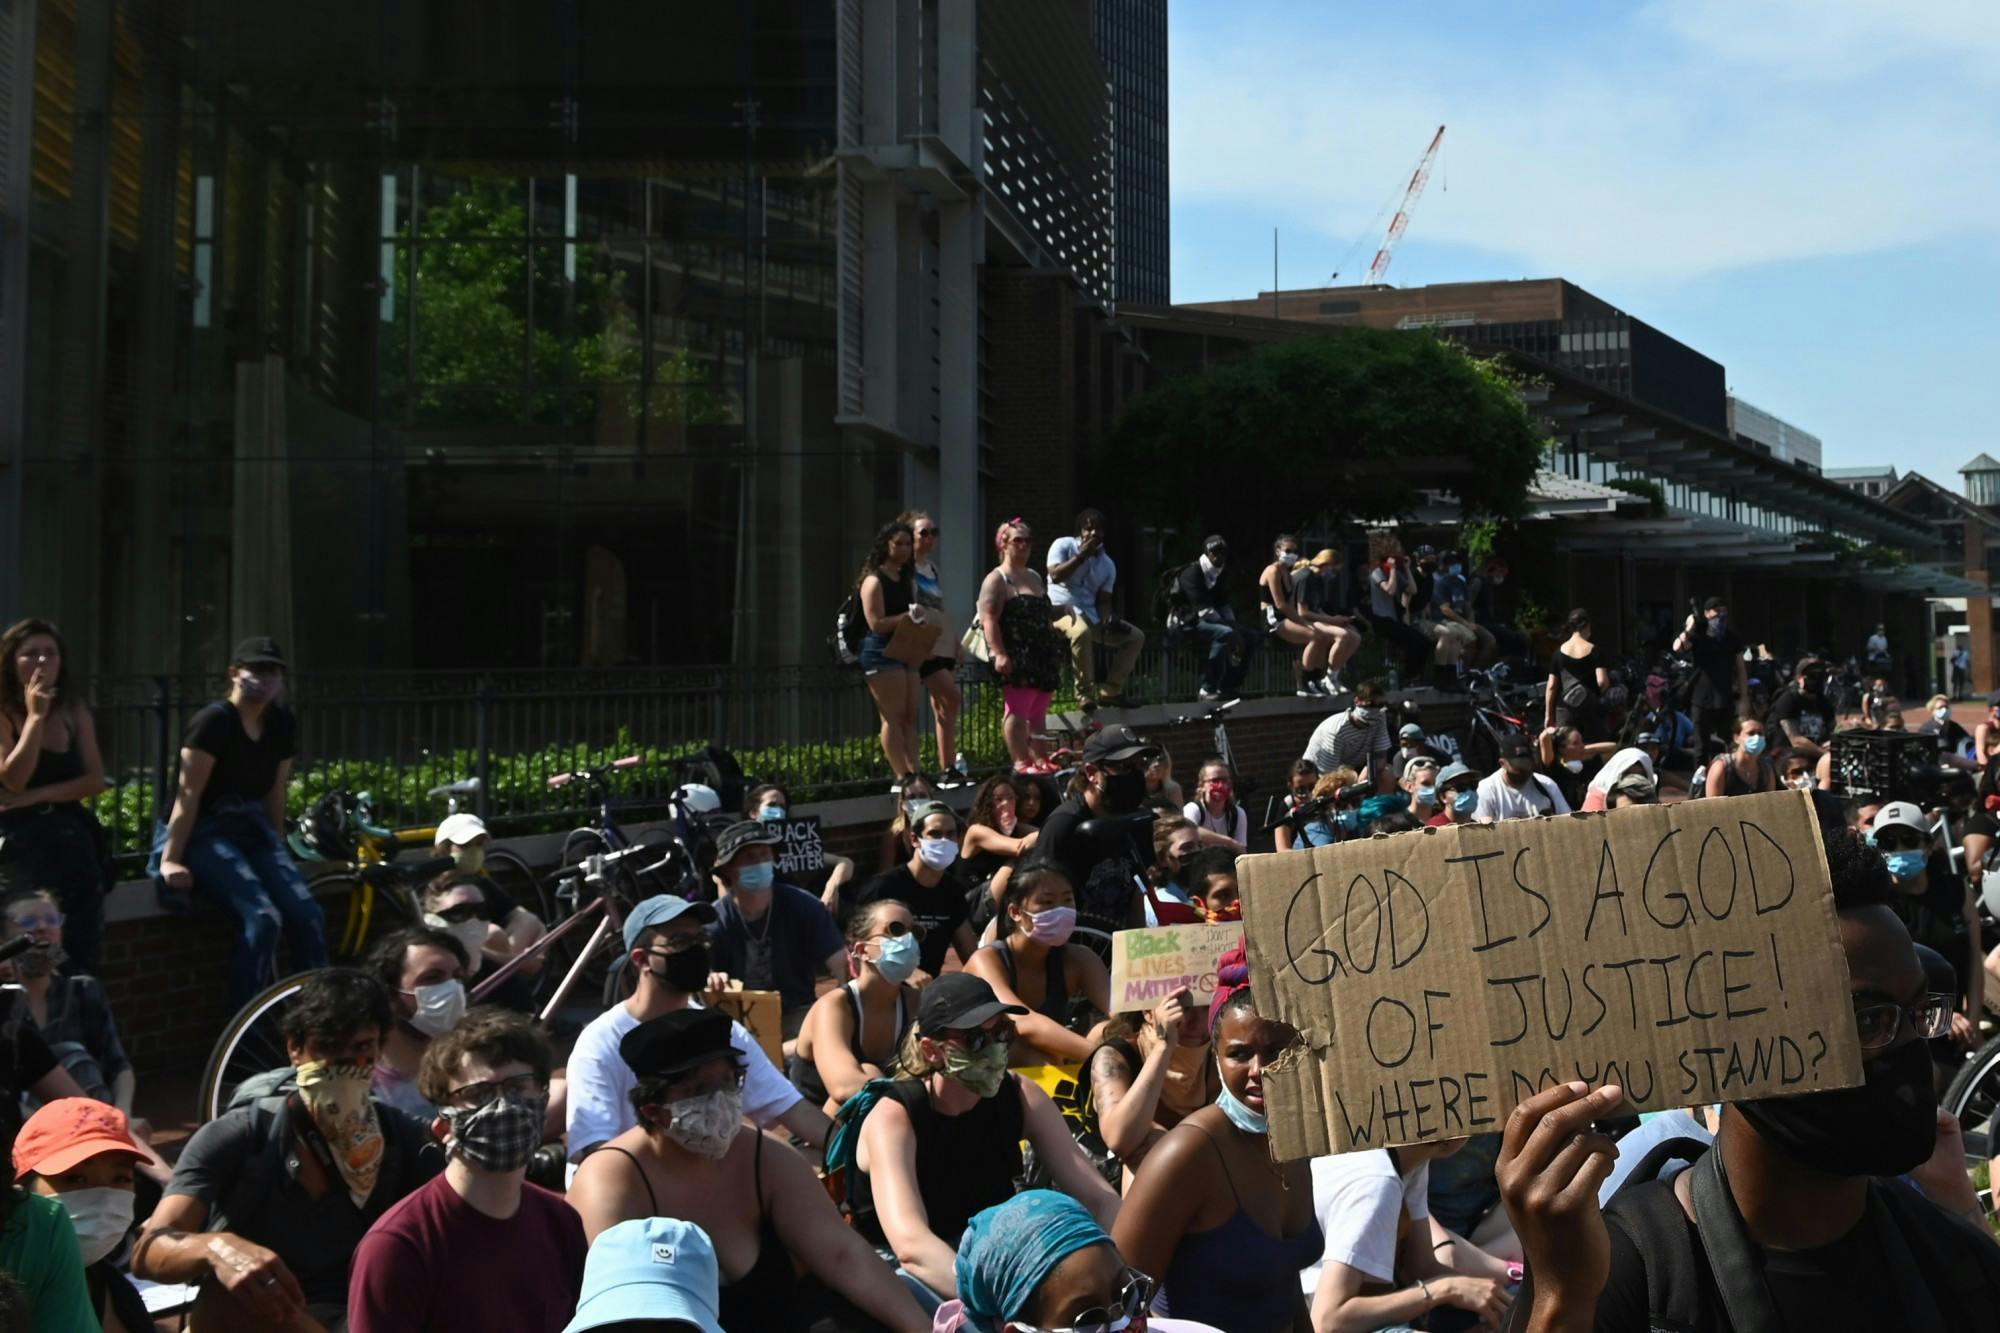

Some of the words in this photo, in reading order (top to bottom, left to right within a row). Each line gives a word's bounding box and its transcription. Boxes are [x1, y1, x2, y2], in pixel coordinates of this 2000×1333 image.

[768, 822, 820, 842] BLACK
[1284, 869, 1429, 985] GOD
[1444, 847, 1551, 952] IS
[1584, 839, 1625, 941] A
[1642, 820, 1795, 929] GOD
[1127, 955, 1185, 978] LIVES
[1366, 990, 1450, 1068] OF
[1489, 933, 1788, 1047] JUSTICE!
[1335, 1072, 1496, 1147] WHERE
[1575, 1060, 1654, 1104] YOU
[1678, 1030, 1827, 1095] STAND?
